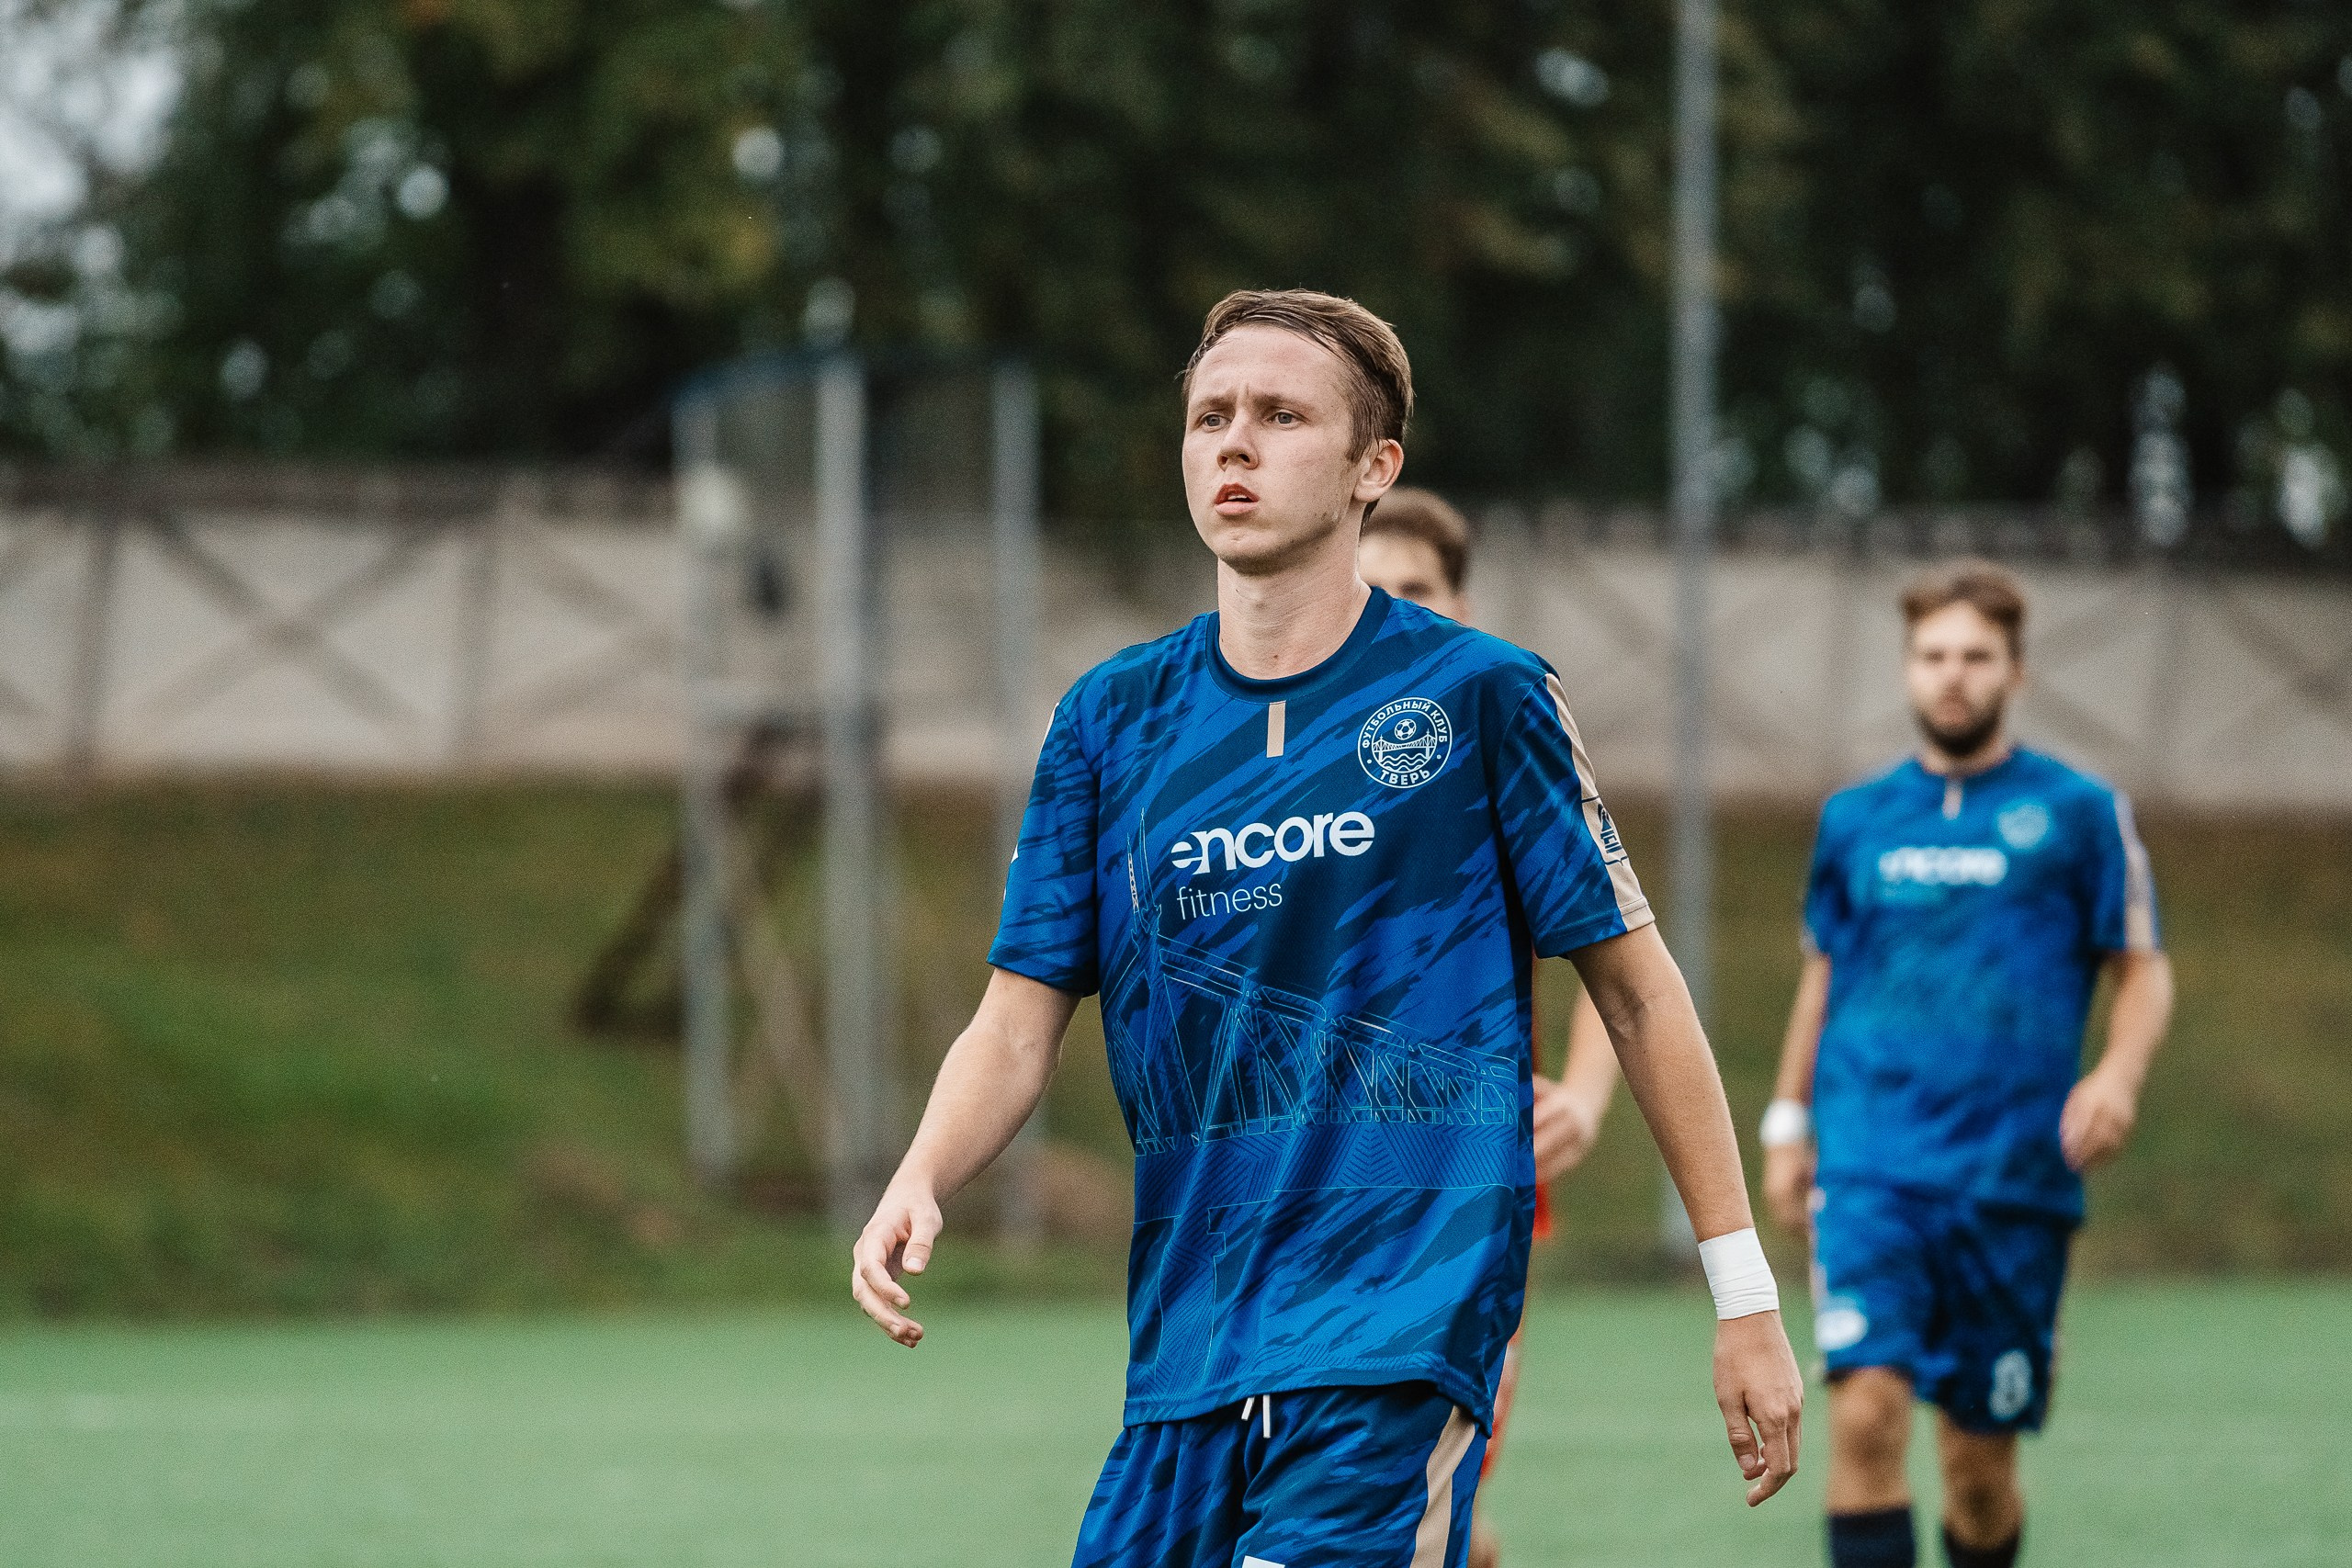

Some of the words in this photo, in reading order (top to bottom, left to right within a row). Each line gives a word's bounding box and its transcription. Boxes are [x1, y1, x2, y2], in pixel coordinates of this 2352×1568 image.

[1362, 701, 1430, 749] ФУТБОЛЬНЫЙ
[1430, 710, 1447, 743] КЛУБ
[1379, 769, 1430, 785] ТВЕРЬ
[1170, 811, 1375, 874] encore
[1176, 883, 1283, 919] fitness
